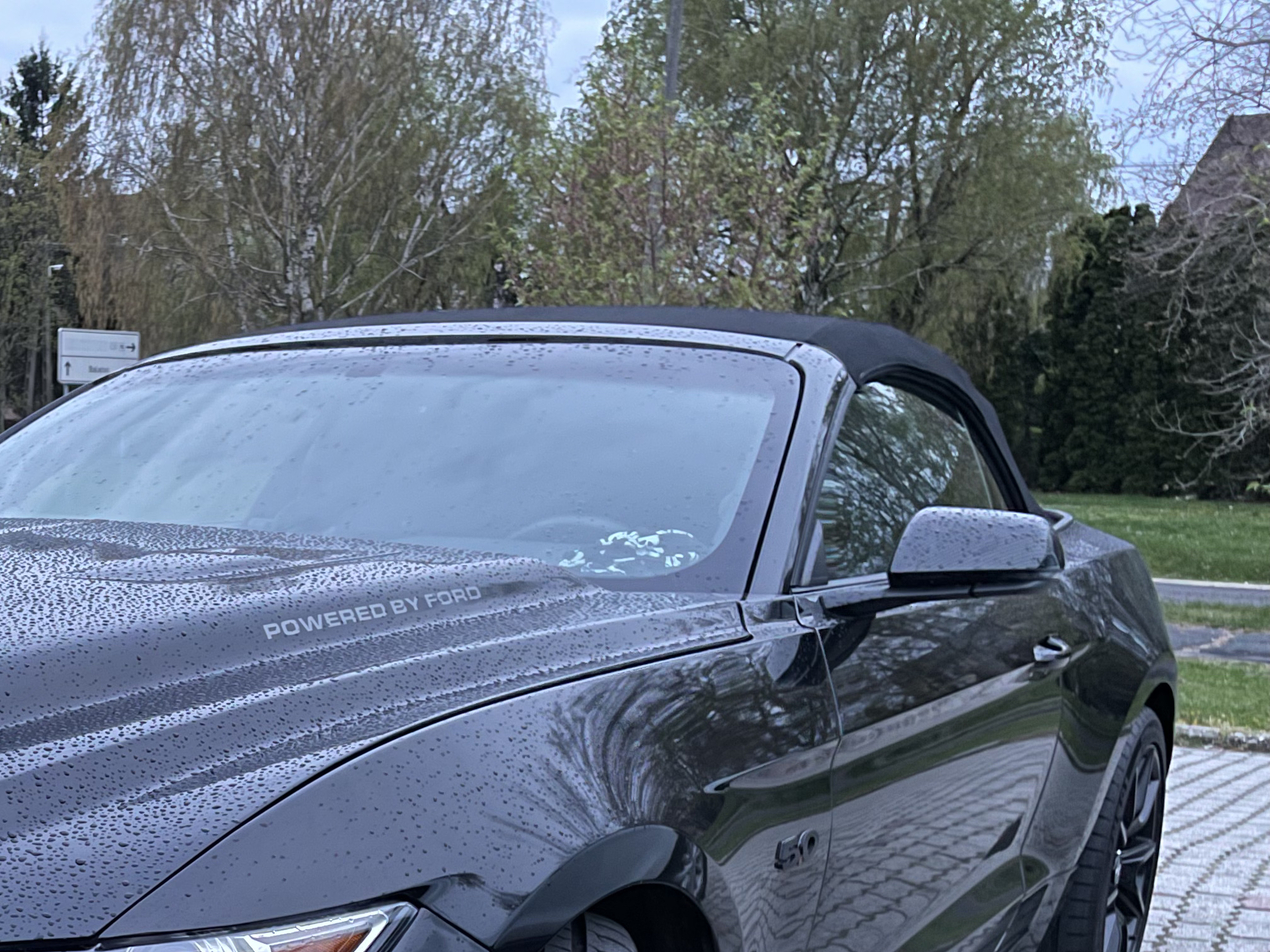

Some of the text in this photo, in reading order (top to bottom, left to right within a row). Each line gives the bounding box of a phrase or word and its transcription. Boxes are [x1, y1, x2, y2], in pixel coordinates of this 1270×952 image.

[262, 585, 482, 640] POWERED BY FORD
